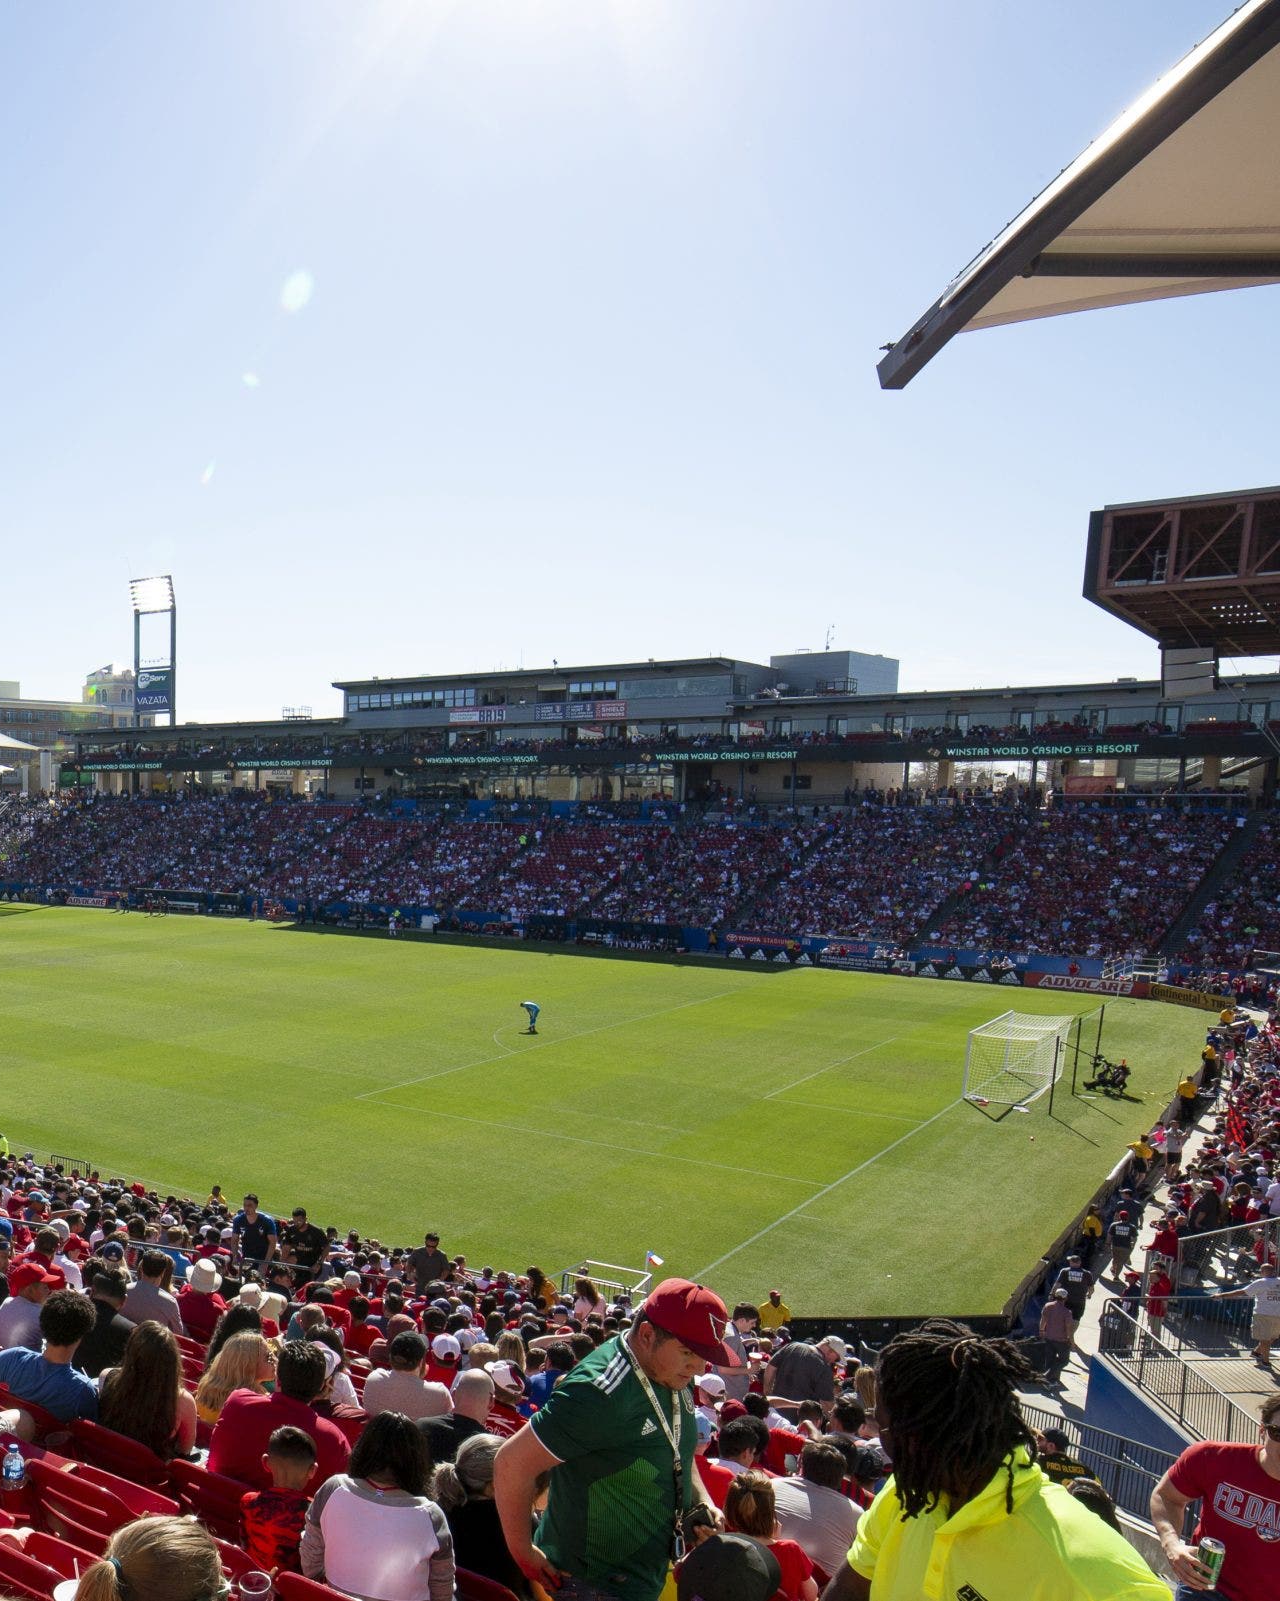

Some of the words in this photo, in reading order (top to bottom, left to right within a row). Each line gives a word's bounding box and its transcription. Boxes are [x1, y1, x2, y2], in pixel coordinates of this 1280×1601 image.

[136, 695, 169, 705] VAZATA
[720, 752, 750, 760] CASINO
[766, 751, 798, 759] RESORT
[946, 748, 990, 756] WINSTAR
[992, 747, 1029, 755] WORLD
[1031, 745, 1072, 754] CASINO
[1095, 743, 1139, 754] RESORT
[1039, 975, 1135, 994] ADVOCARE
[1150, 985, 1200, 1004] Continental
[641, 1425, 658, 1436] adidas
[1213, 1482, 1245, 1516] FC
